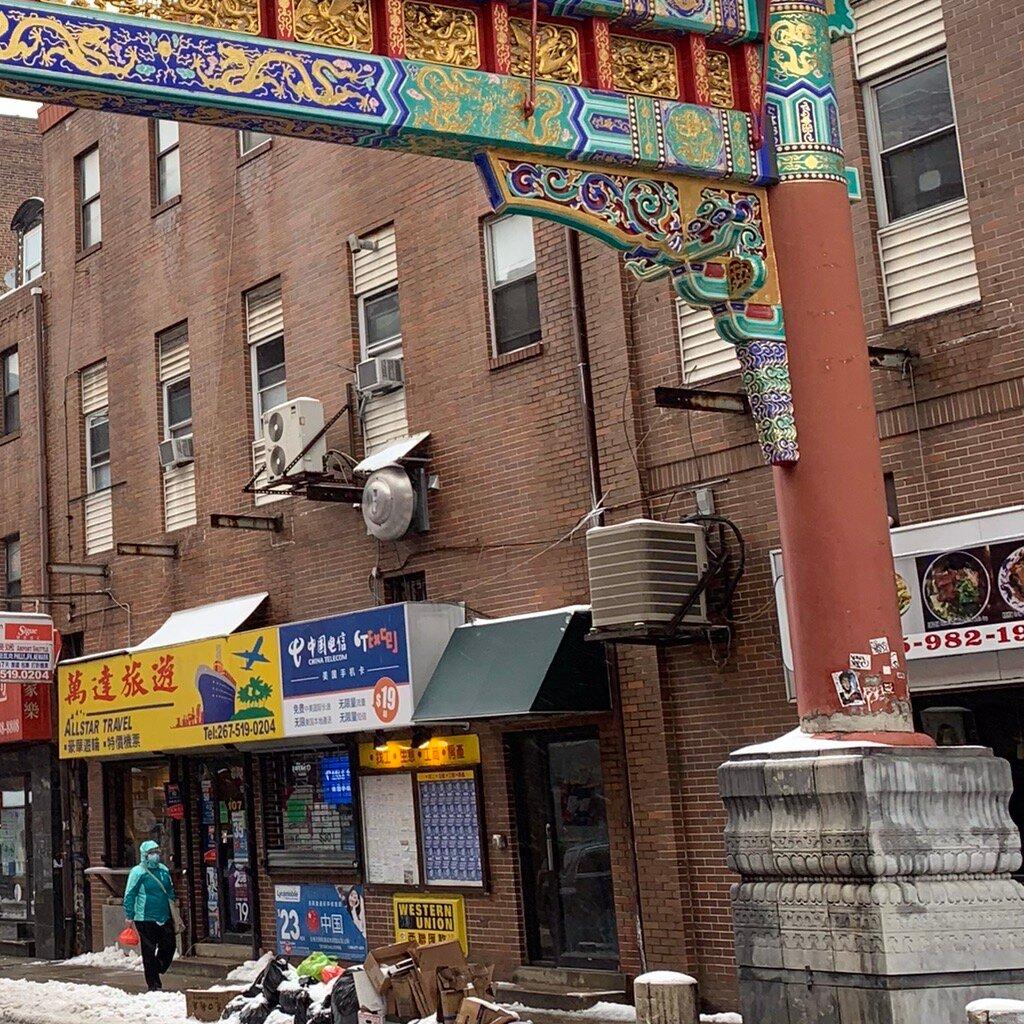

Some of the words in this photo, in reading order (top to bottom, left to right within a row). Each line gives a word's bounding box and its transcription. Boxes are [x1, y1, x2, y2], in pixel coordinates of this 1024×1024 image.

[308, 657, 324, 666] CHINA
[324, 653, 348, 663] TELECOM
[65, 654, 179, 705] 萬達旅遊
[376, 685, 396, 711] $19
[64, 718, 100, 737] ALLSTAR
[103, 715, 133, 733] TRAVEL
[227, 800, 242, 811] 107
[398, 903, 452, 917] WESTERN
[416, 916, 453, 930] UNION
